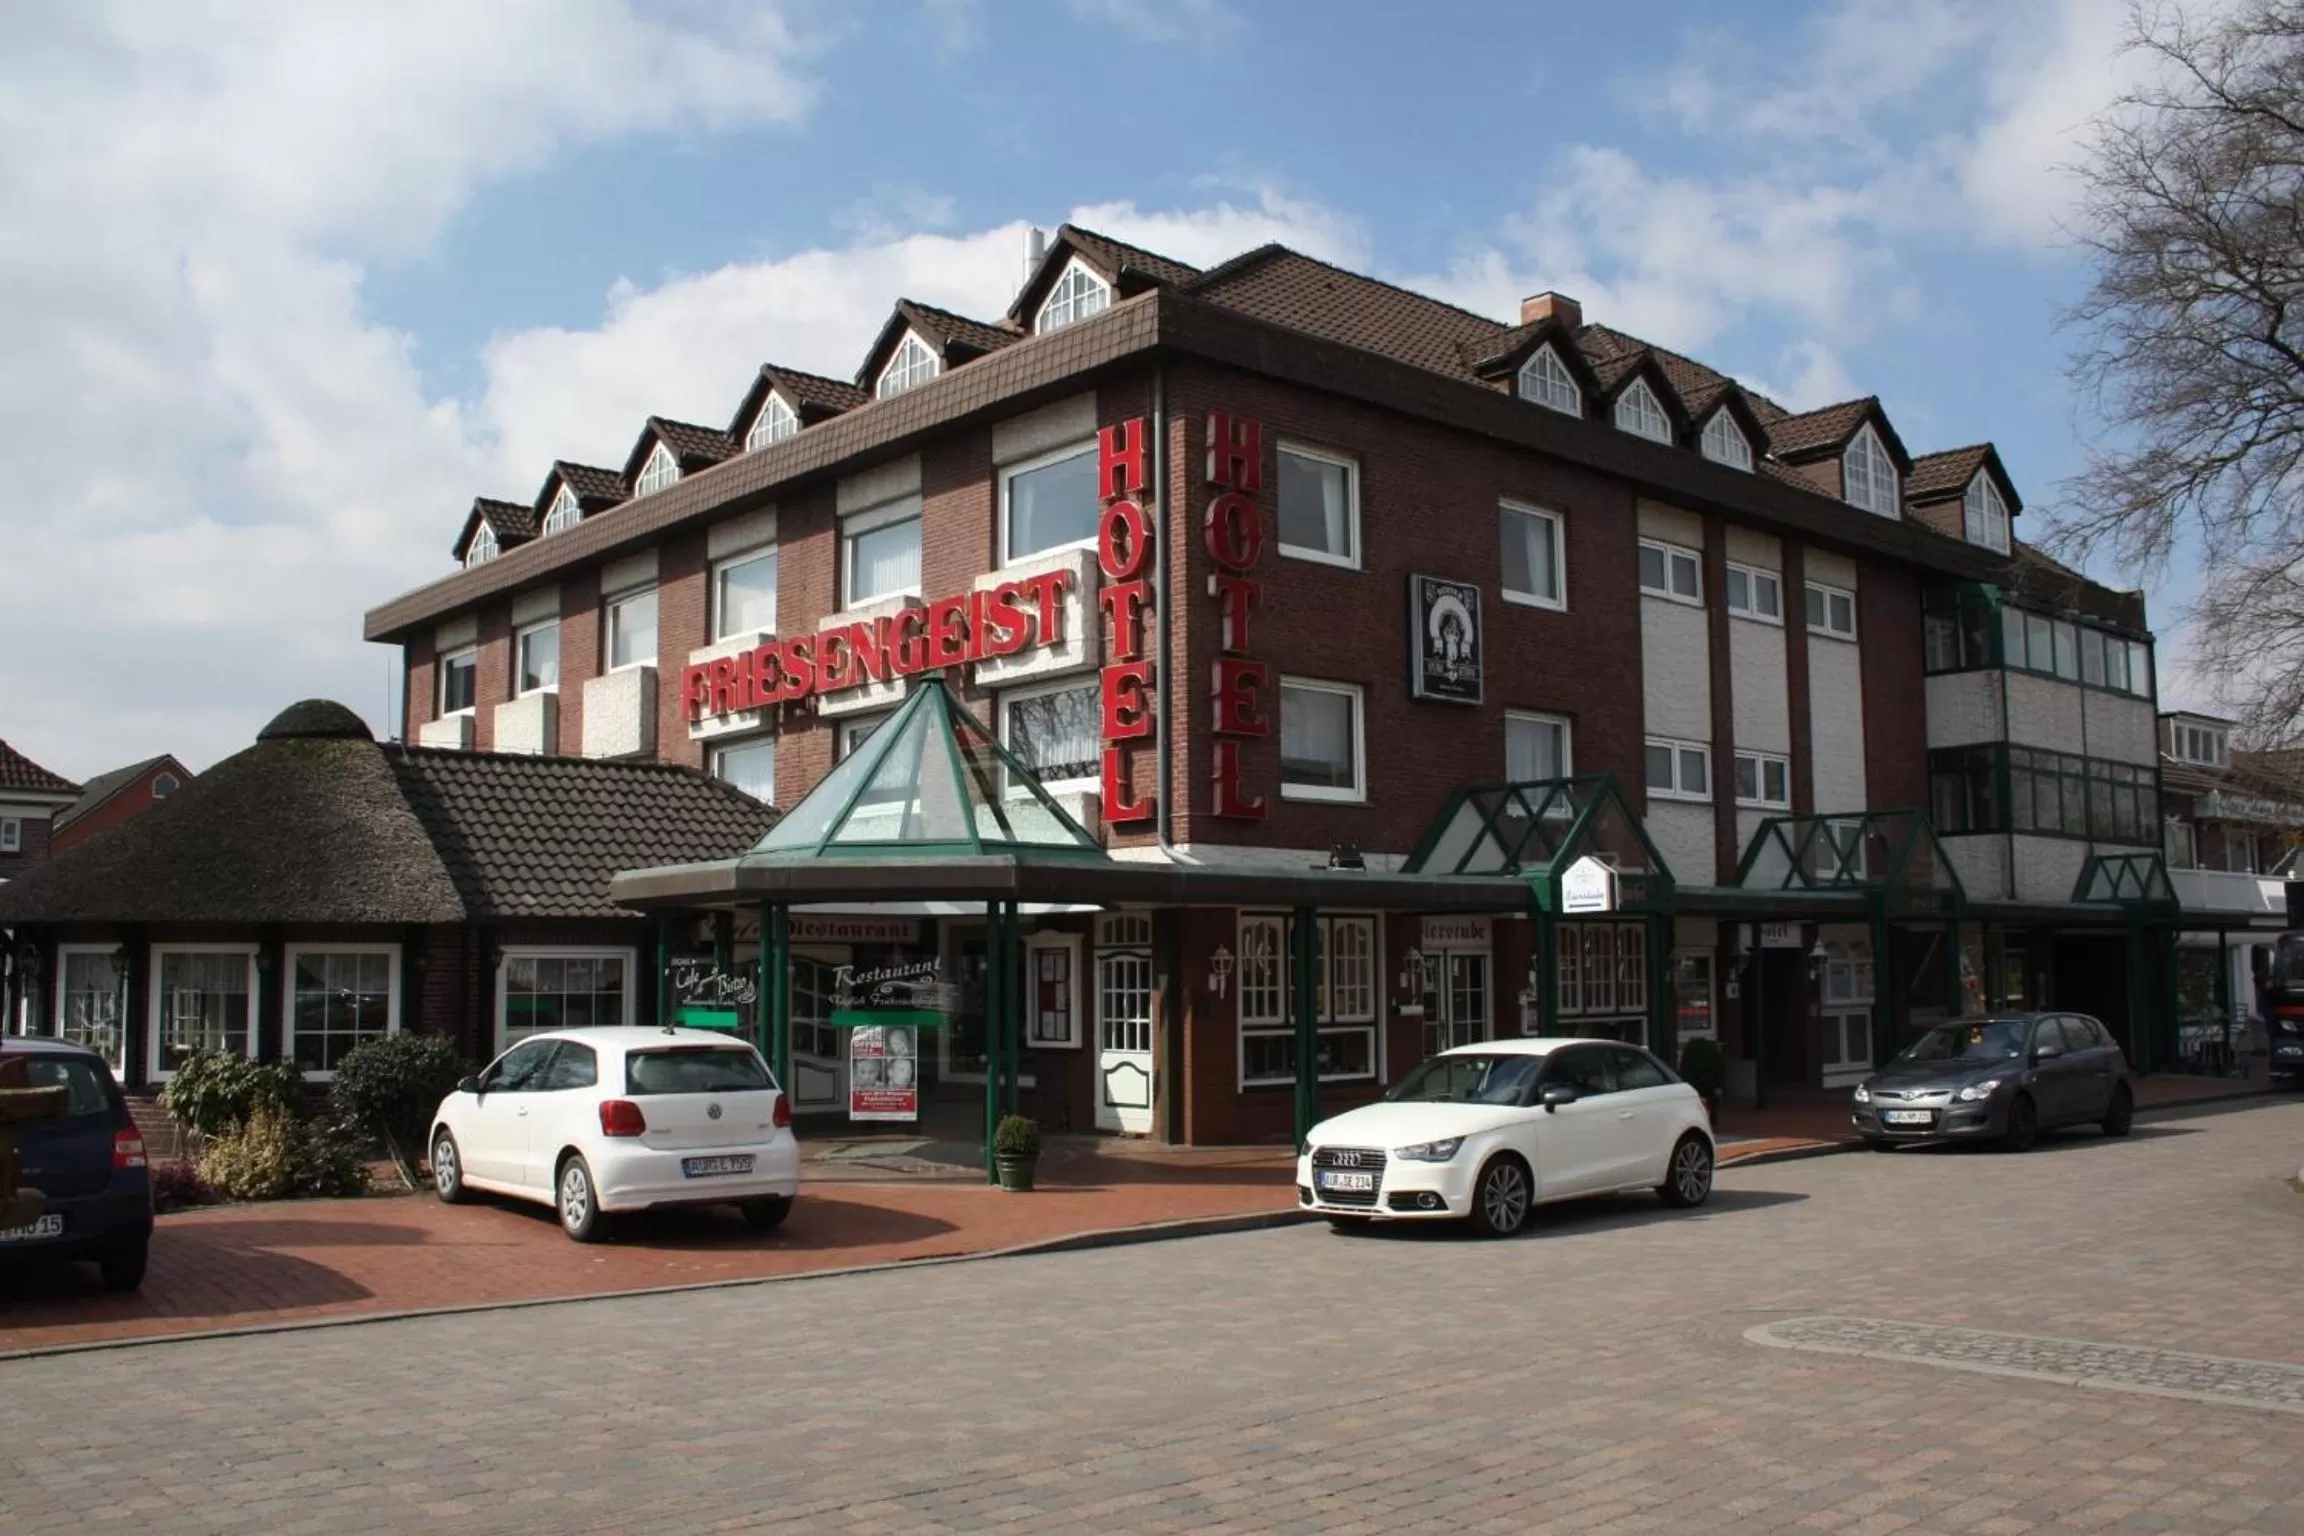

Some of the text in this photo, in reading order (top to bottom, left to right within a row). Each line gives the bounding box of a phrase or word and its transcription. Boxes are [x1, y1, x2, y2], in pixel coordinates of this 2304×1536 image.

[680, 568, 1073, 722] FRIESENGEIST
[1097, 416, 1155, 823] HOTEL
[1205, 410, 1269, 820] HOTEL
[831, 955, 941, 988] Restaurant
[40, 1217, 61, 1233] 15
